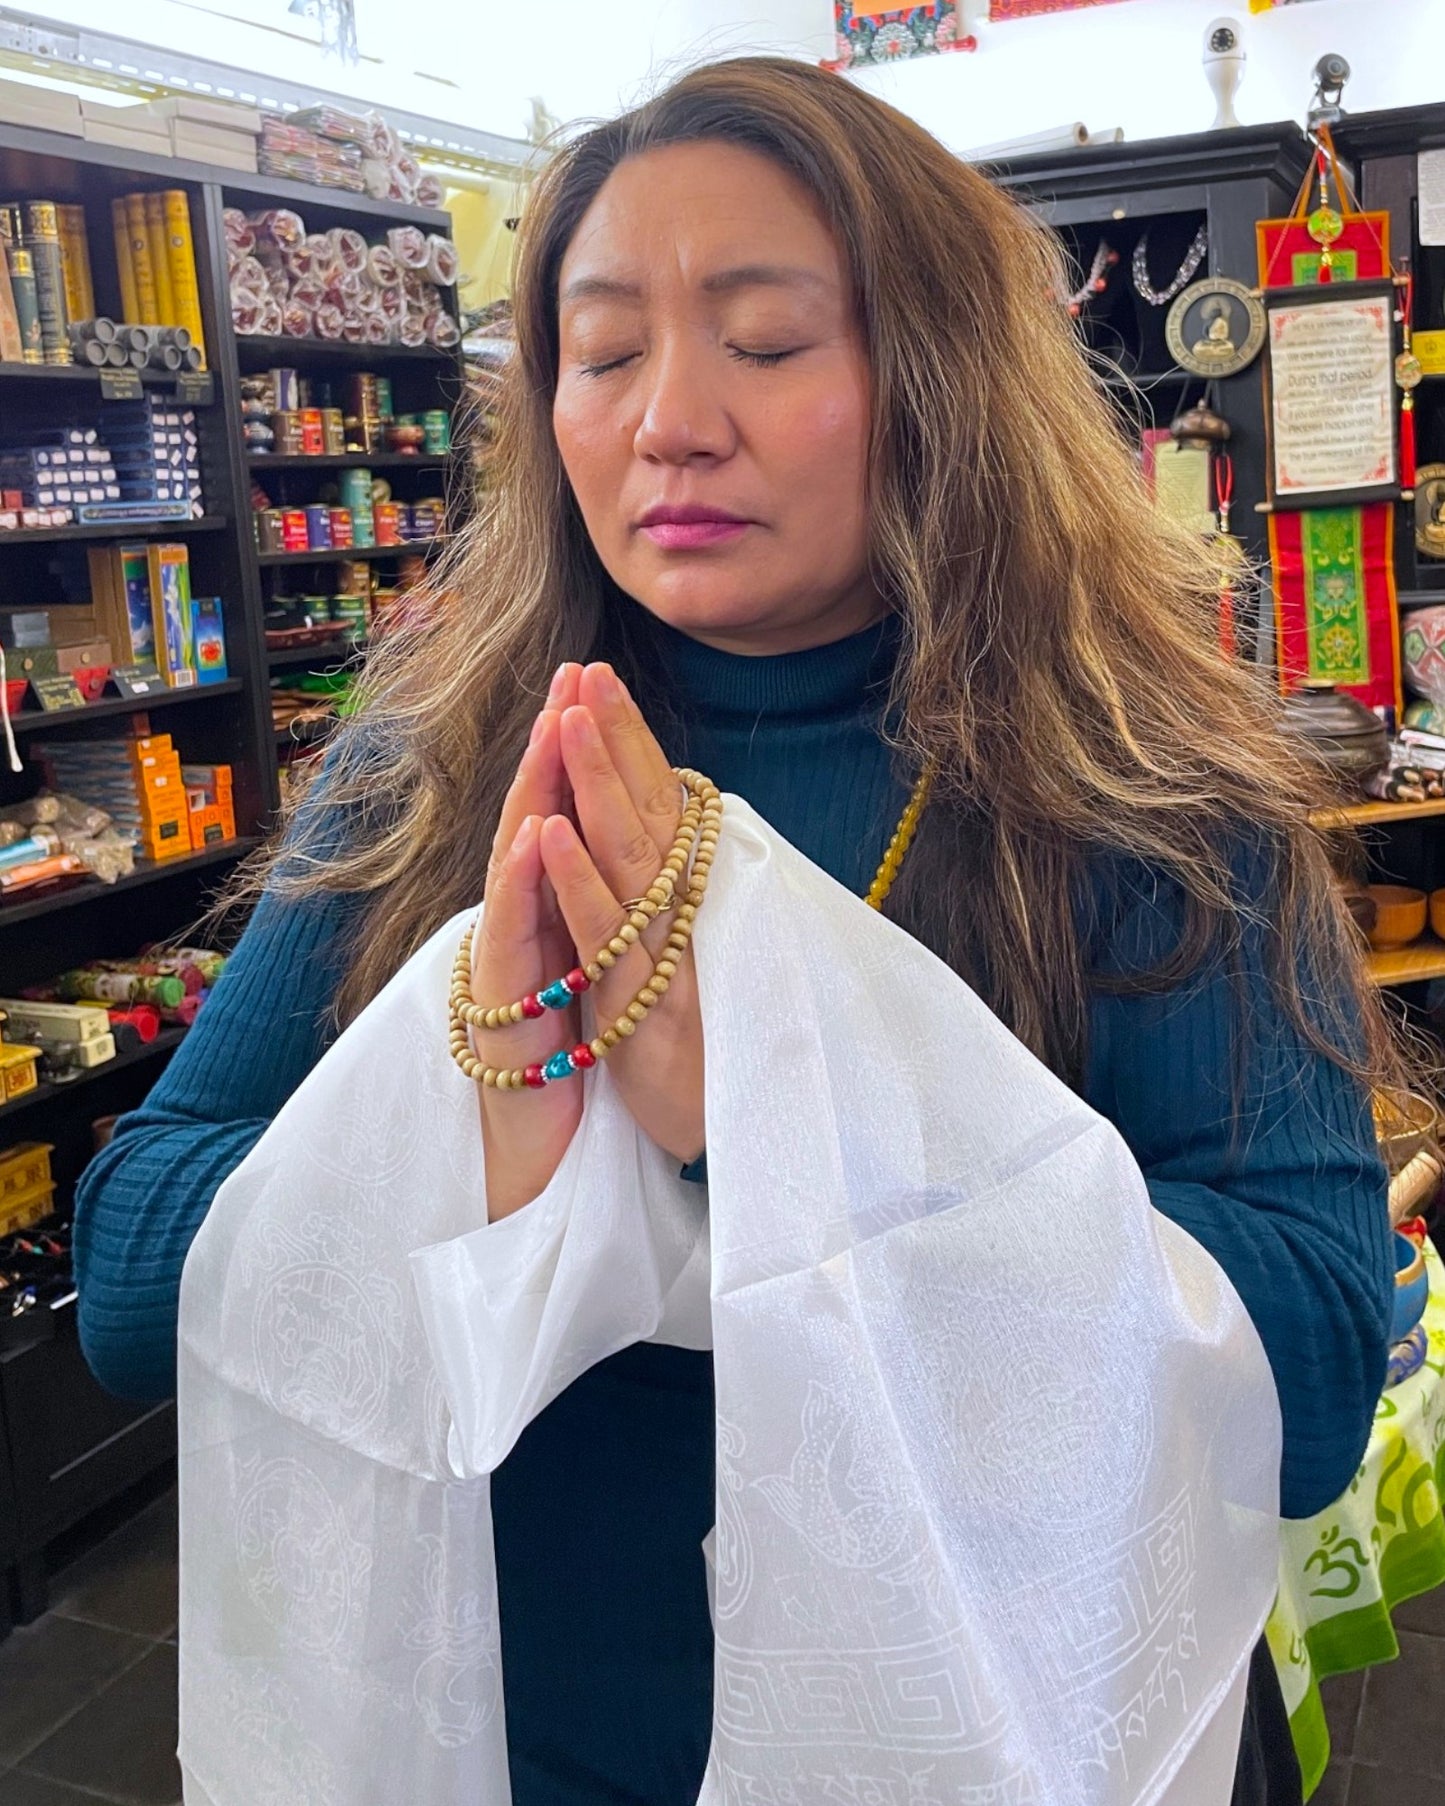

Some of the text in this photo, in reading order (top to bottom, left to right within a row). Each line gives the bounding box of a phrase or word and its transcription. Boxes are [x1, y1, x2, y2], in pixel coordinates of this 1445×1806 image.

[1300, 352, 1314, 361] are
[1315, 349, 1334, 359] here
[1336, 348, 1347, 357] for
[1288, 374, 1316, 388] During
[1319, 371, 1337, 383] that
